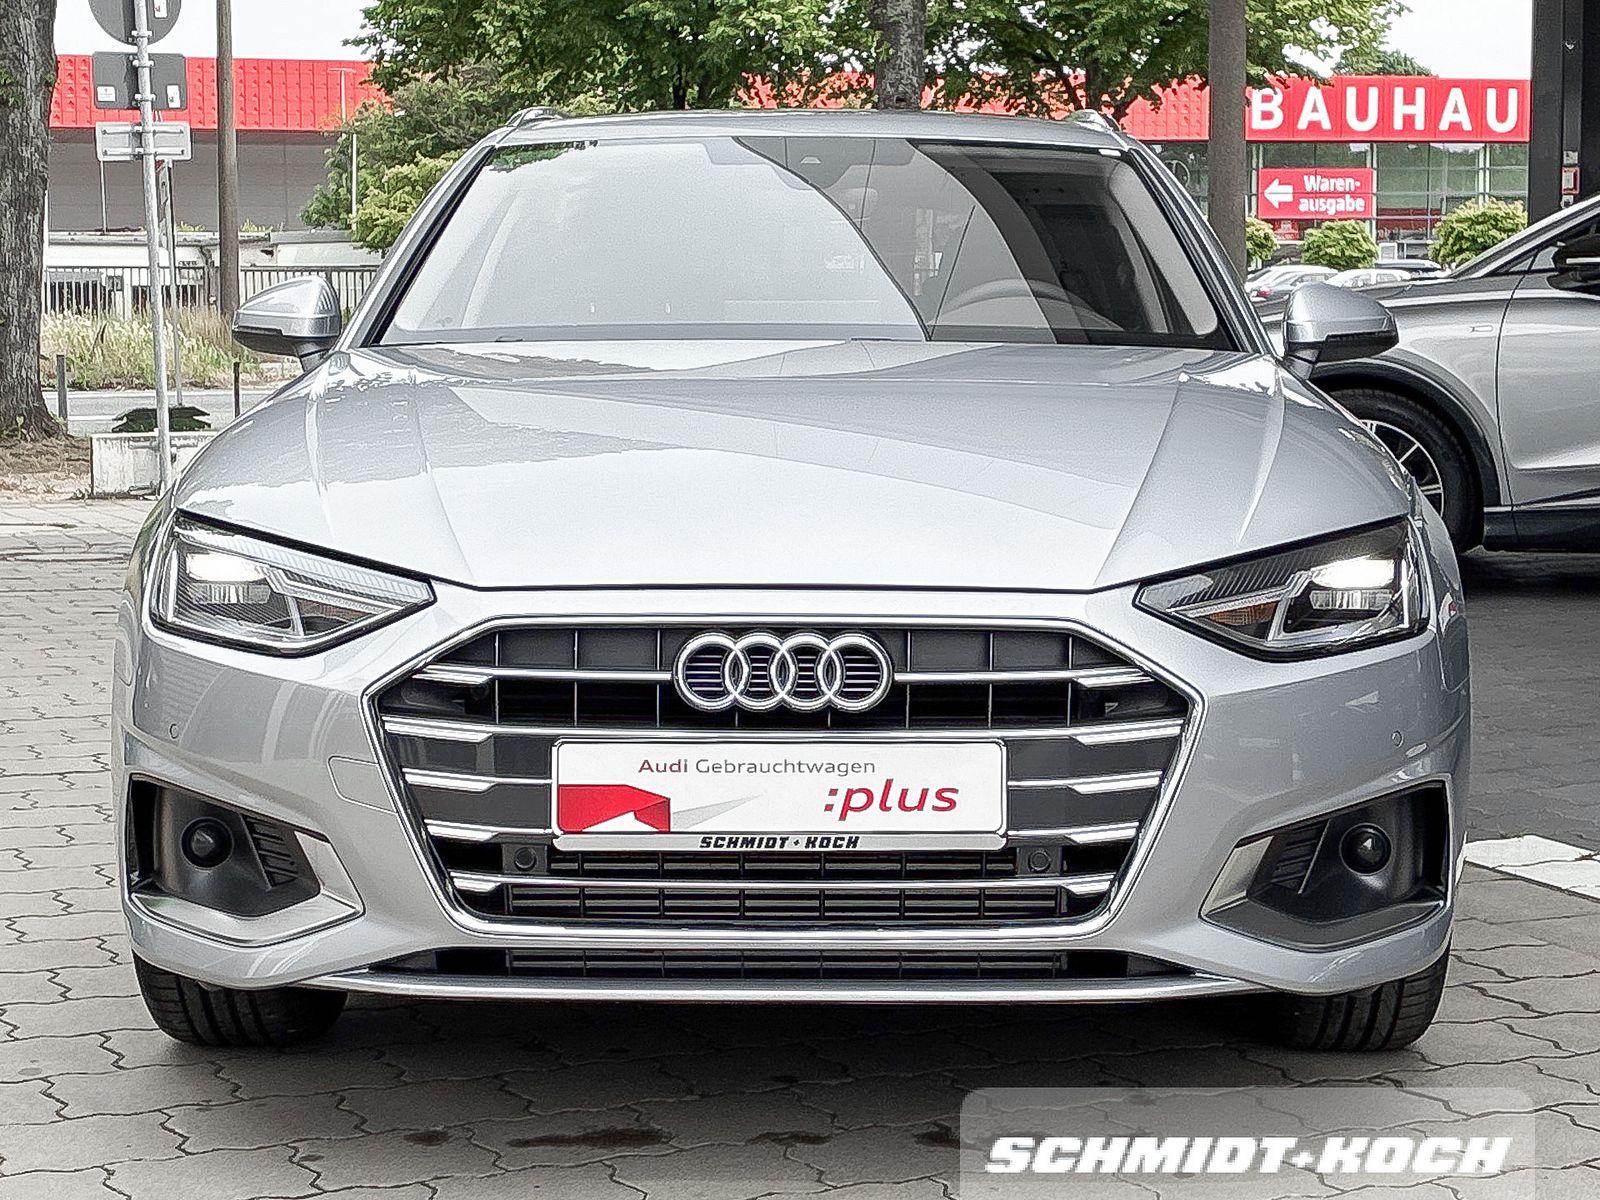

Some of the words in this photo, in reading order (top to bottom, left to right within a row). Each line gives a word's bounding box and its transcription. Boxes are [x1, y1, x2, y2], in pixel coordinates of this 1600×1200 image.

[1303, 174, 1361, 193] Waren-
[1298, 194, 1366, 216] ausgabe
[638, 758, 688, 774] Audi
[695, 758, 876, 778] Gebrauchtwagen
